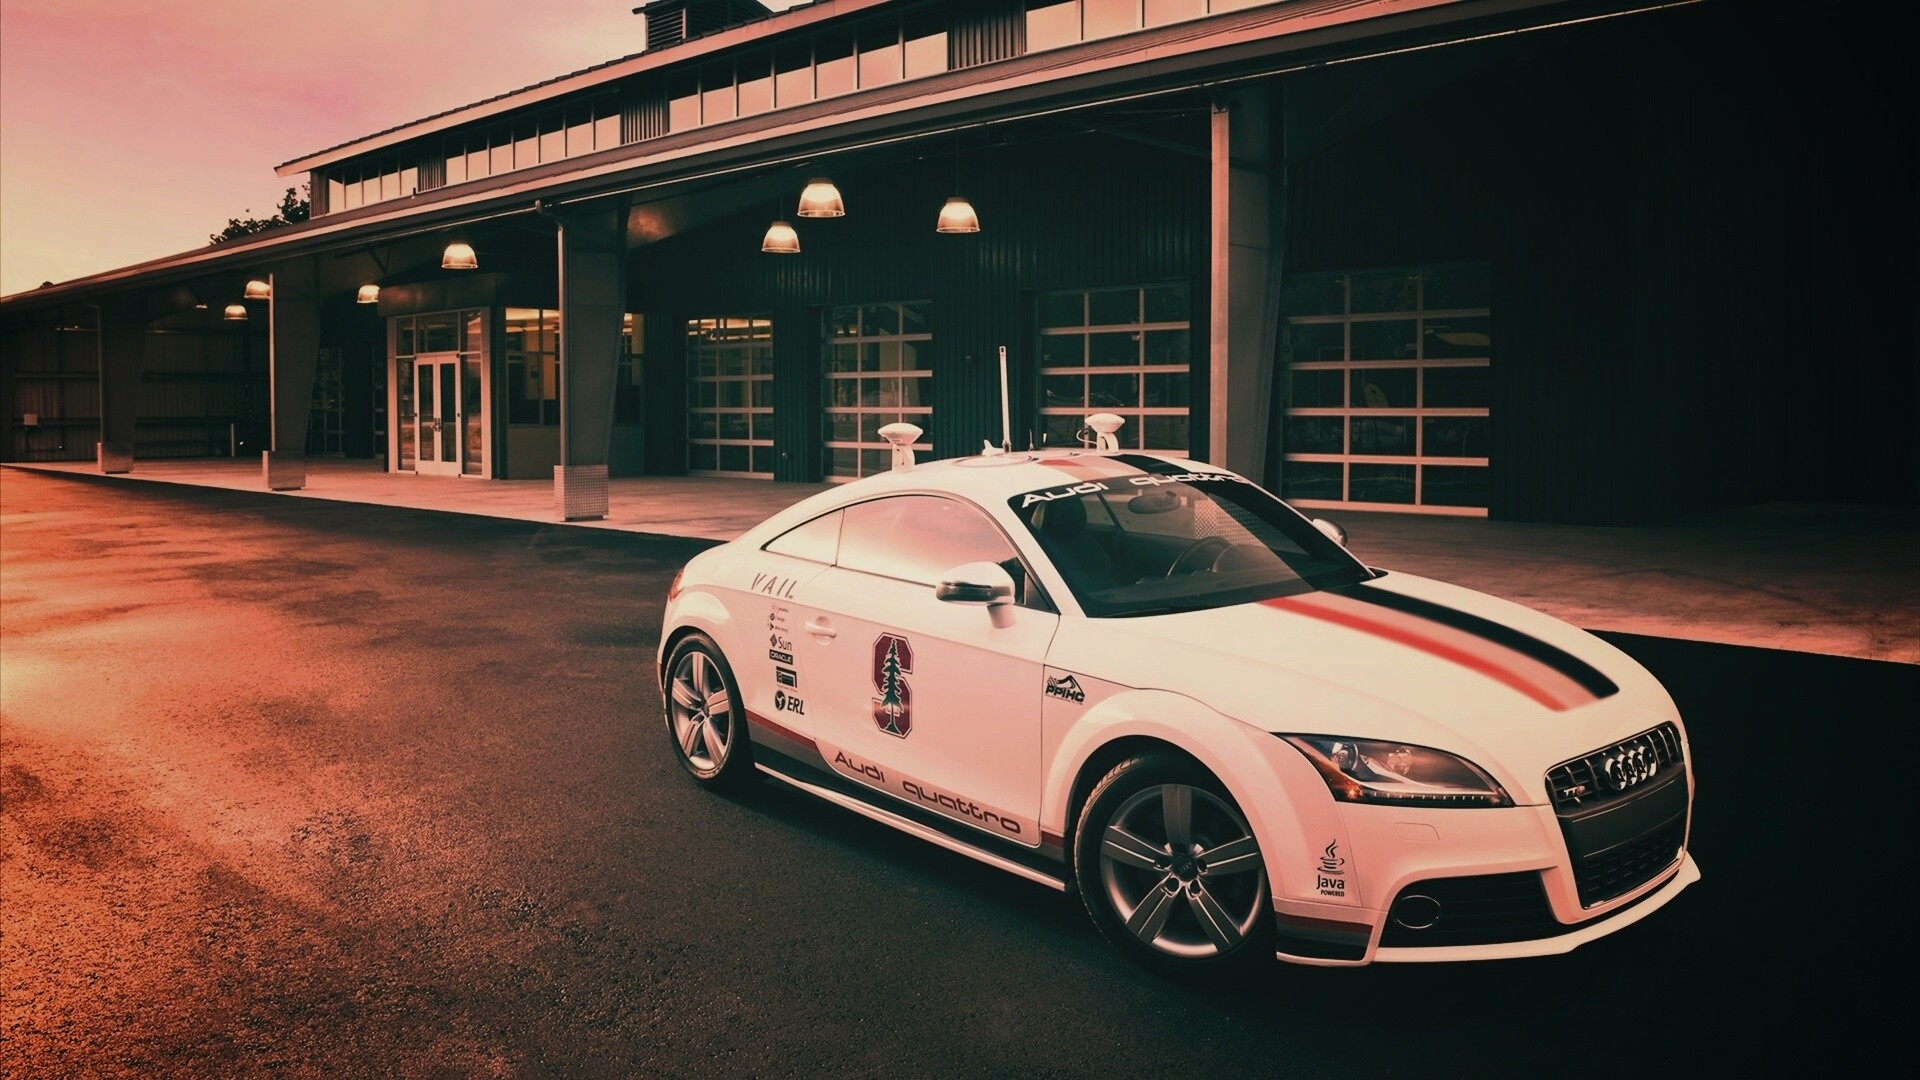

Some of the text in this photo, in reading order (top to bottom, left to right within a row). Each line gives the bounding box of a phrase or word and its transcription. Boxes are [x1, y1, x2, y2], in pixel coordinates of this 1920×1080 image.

[778, 636, 793, 652] Sun
[770, 651, 792, 664] ORACLE
[787, 695, 805, 716] ERL
[835, 751, 1021, 834] Audi quattro
[1316, 874, 1345, 890] Java
[1320, 889, 1345, 897] POWERED
